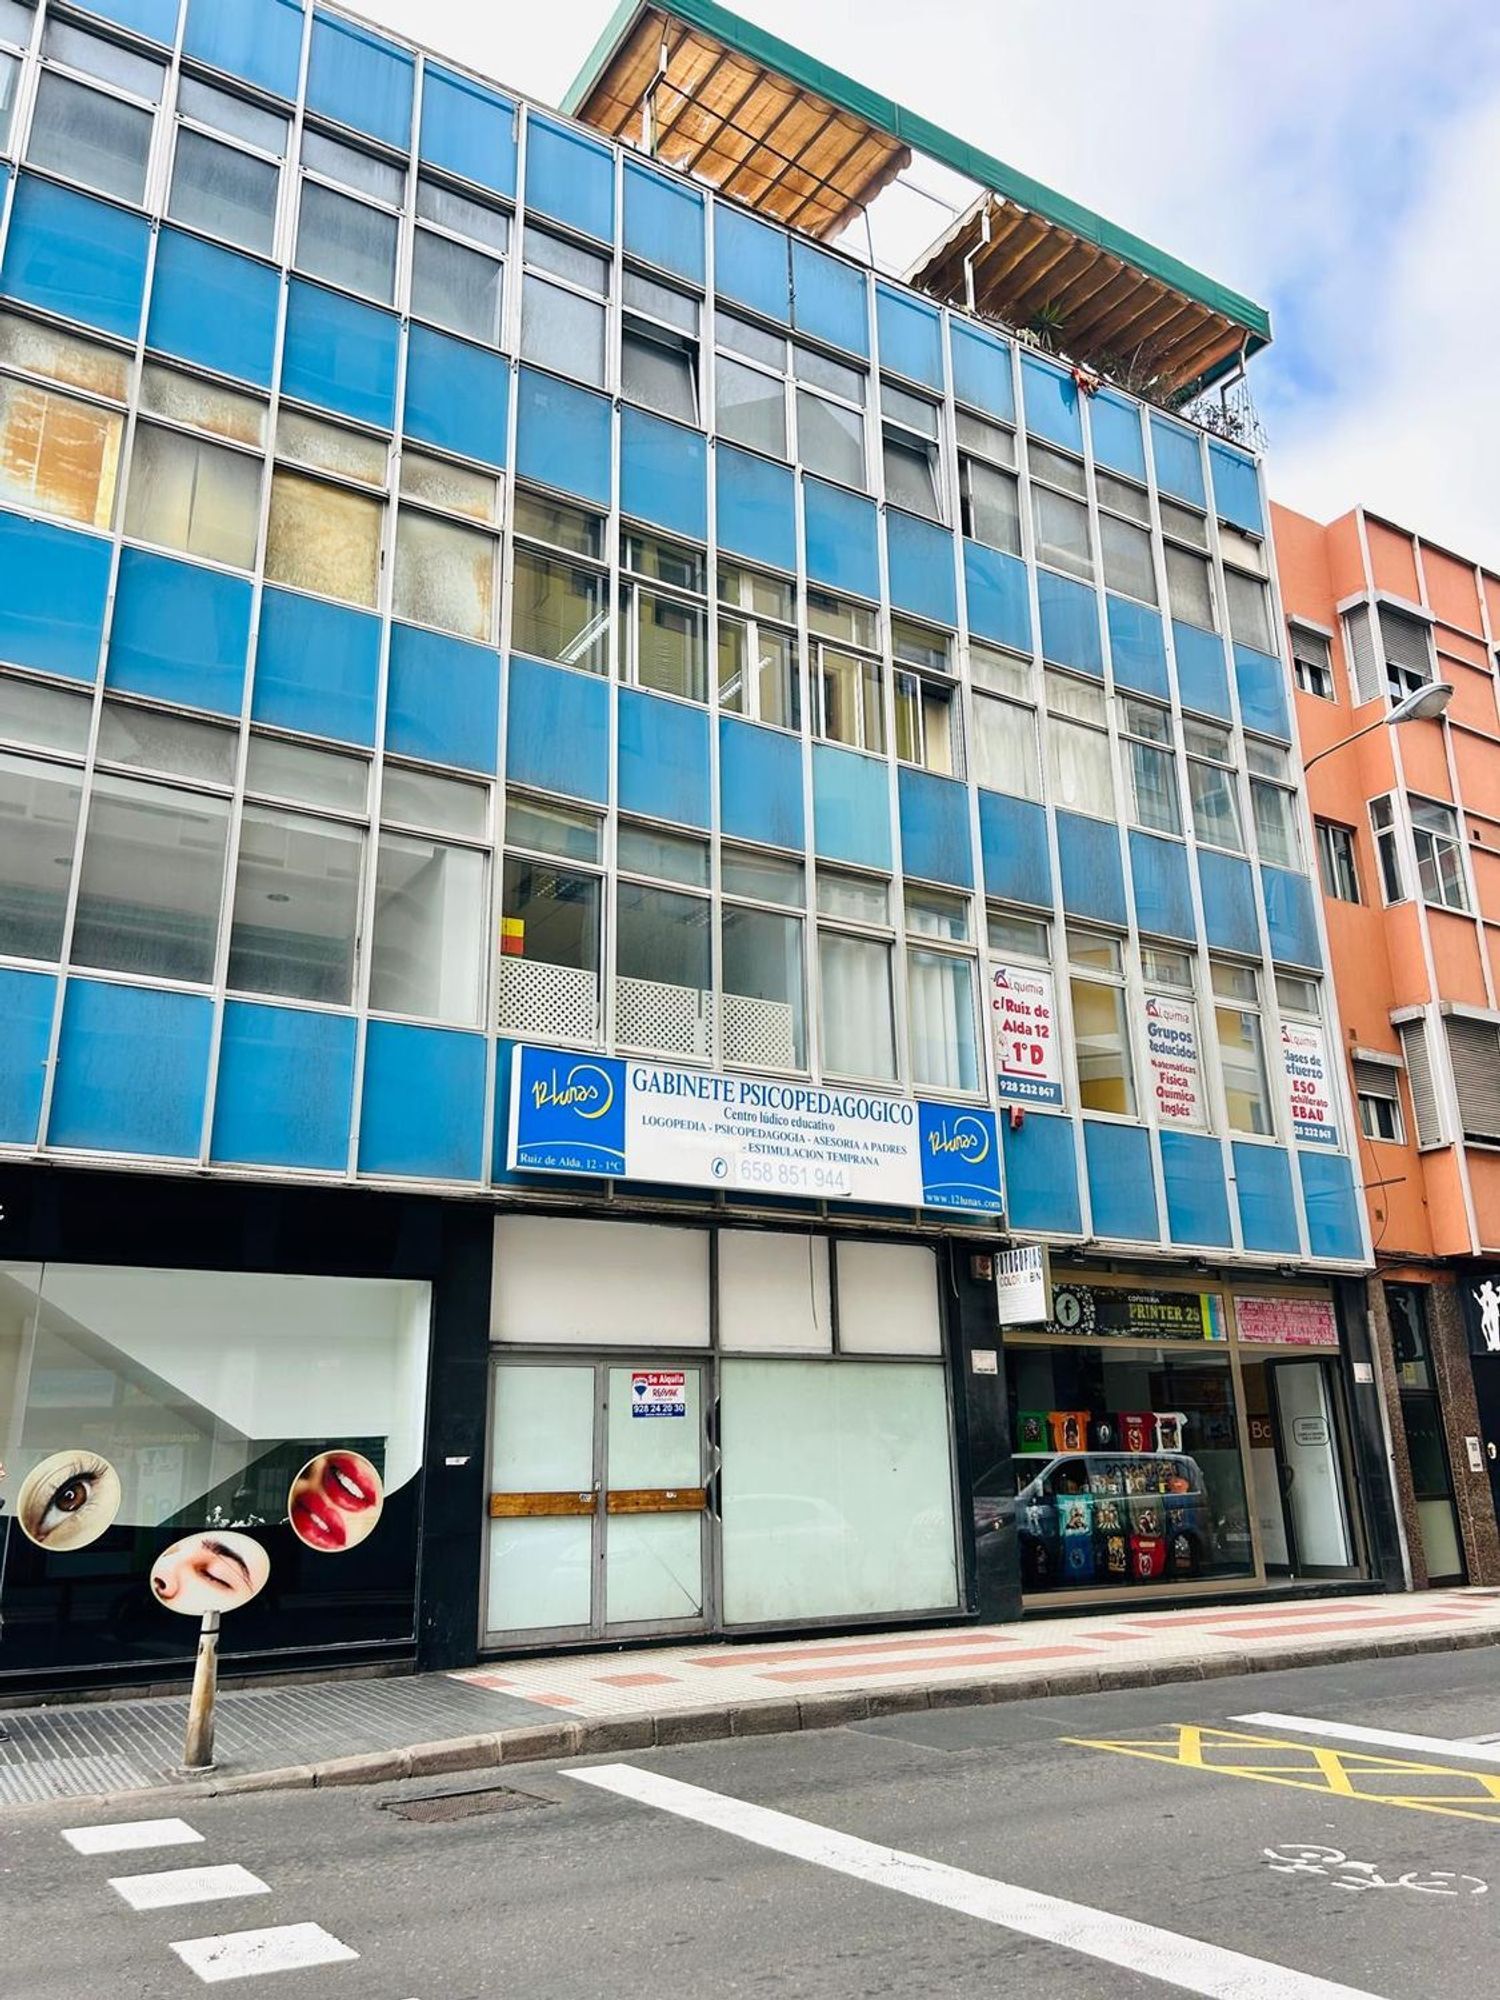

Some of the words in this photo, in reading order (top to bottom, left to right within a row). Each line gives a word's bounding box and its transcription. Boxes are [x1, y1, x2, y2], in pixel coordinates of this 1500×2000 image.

[1034, 1005, 1049, 1018] de
[1002, 1019, 1032, 1036] Alda
[1035, 1024, 1049, 1038] 12
[1147, 1022, 1193, 1043] Grupos
[1309, 1055, 1321, 1067] de
[1286, 1062, 1323, 1079] efuerzo
[1000, 1080, 1018, 1092] 928
[1292, 1080, 1315, 1094] ESO
[632, 1068, 735, 1103] GABINETE
[740, 1082, 913, 1126] PSICOPEDAGOGICO
[1290, 1094, 1328, 1108] achillerato
[1161, 1101, 1190, 1117] Inglés
[1292, 1105, 1324, 1122] EBAU
[723, 1106, 758, 1122] Centro
[760, 1110, 789, 1126] lúdico
[791, 1116, 835, 1132] educativo
[642, 1115, 706, 1132] LOGOPEDIA
[714, 1123, 805, 1143] PSICOPEDAGOGIA
[814, 1136, 860, 1151] ASESORIA
[862, 1142, 869, 1151] A
[871, 1142, 907, 1155] PADRES
[520, 1152, 543, 1165] Ruiz
[544, 1155, 556, 1166] de
[586, 1159, 597, 1169] 12
[748, 1142, 824, 1160] ESTIMULACION
[826, 1151, 879, 1166] TEMPRANA
[741, 1159, 773, 1182] 658
[778, 1163, 808, 1187] 851
[814, 1168, 845, 1190] 944
[1128, 1303, 1183, 1321] PRINTER
[659, 1374, 684, 1386] Alquila
